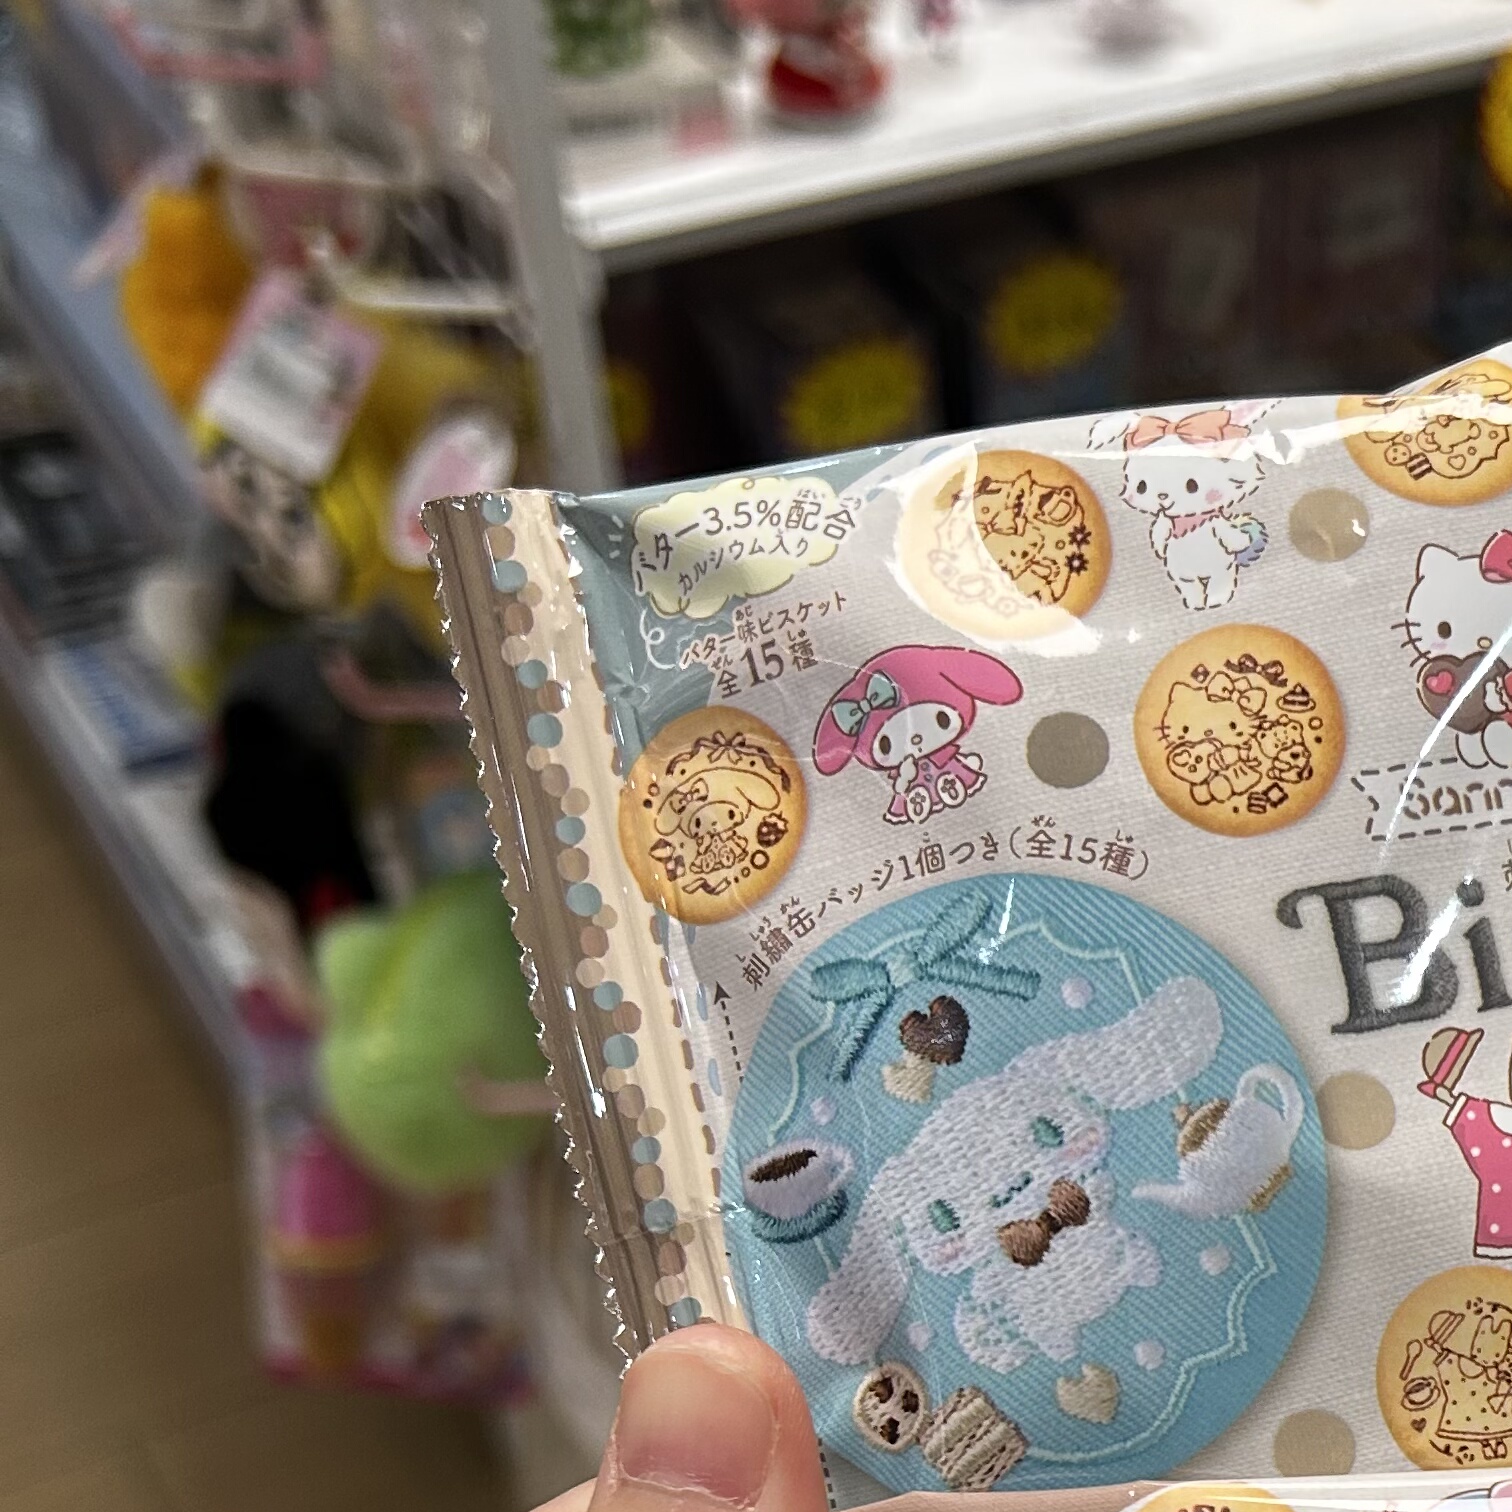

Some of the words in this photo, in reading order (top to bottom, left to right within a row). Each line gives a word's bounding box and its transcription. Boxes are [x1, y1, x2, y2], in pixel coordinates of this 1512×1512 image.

[636, 499, 856, 592] バター3.5%配合
[678, 534, 809, 595] カルシウム入り
[682, 590, 847, 666] バター味ビスケット
[717, 637, 819, 699] 全15種
